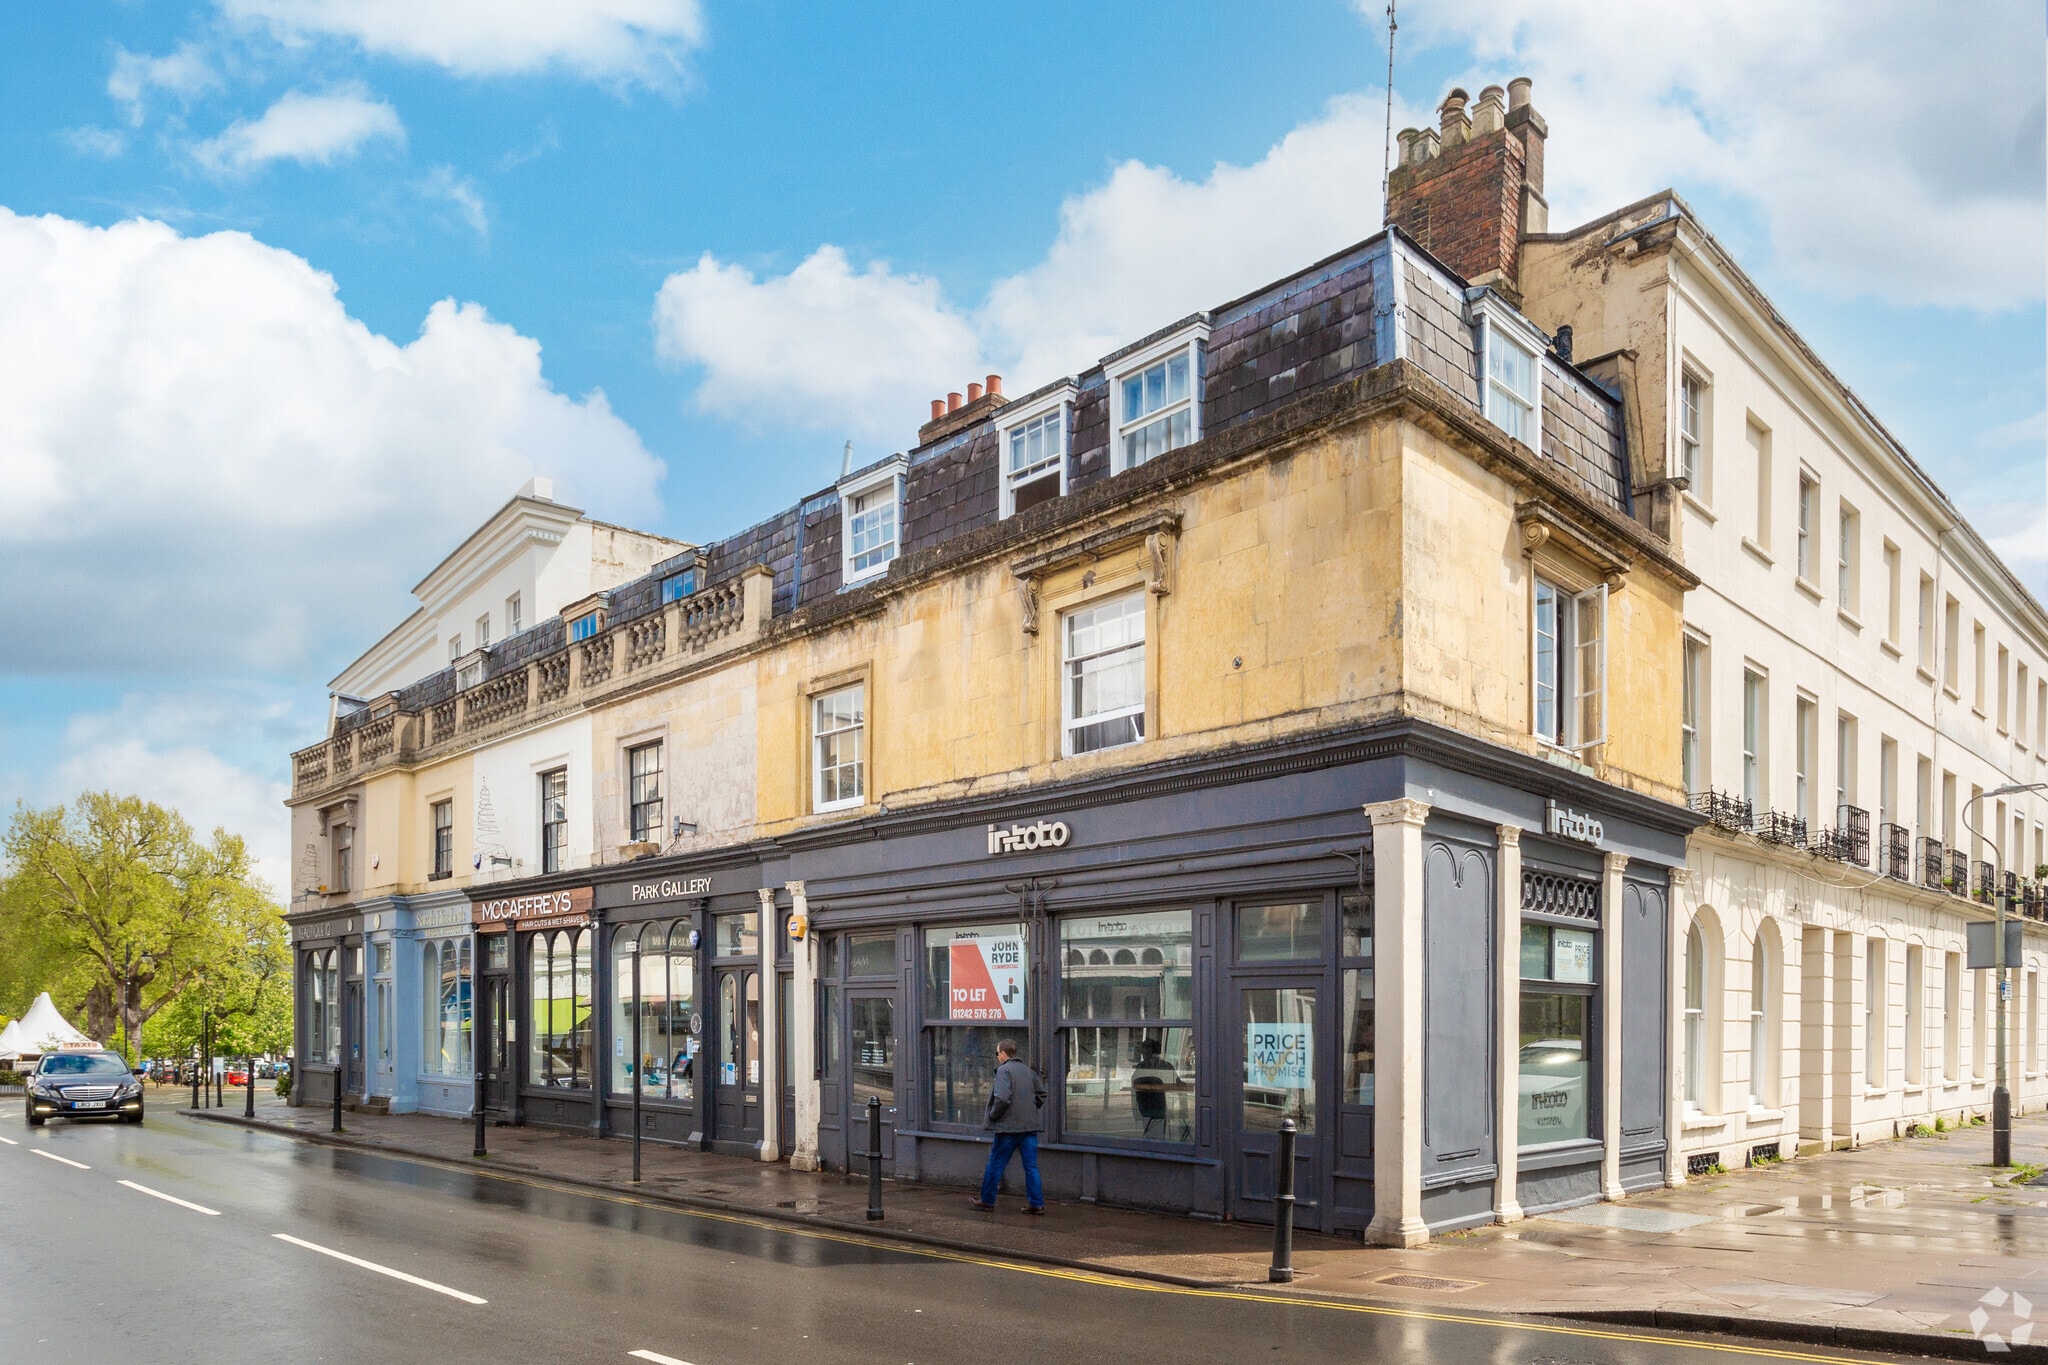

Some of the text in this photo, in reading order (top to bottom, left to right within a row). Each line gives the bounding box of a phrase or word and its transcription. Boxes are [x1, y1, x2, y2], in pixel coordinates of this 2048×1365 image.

[661, 877, 712, 897] GALLERY
[482, 891, 572, 921] MCCAFFREYS
[522, 920, 534, 928] HAIR
[534, 919, 548, 927] CUTS
[548, 918, 552, 926] &
[552, 918, 562, 926] WET
[992, 941, 1018, 952] JOHN
[992, 952, 1018, 964] RYDE
[952, 988, 987, 1002] TO LET
[952, 1008, 1002, 1019] 01242 576 276
[1254, 1034, 1306, 1050] PRICE
[1254, 1051, 1306, 1066] MATCH
[1254, 1066, 1306, 1078] PROMISE
